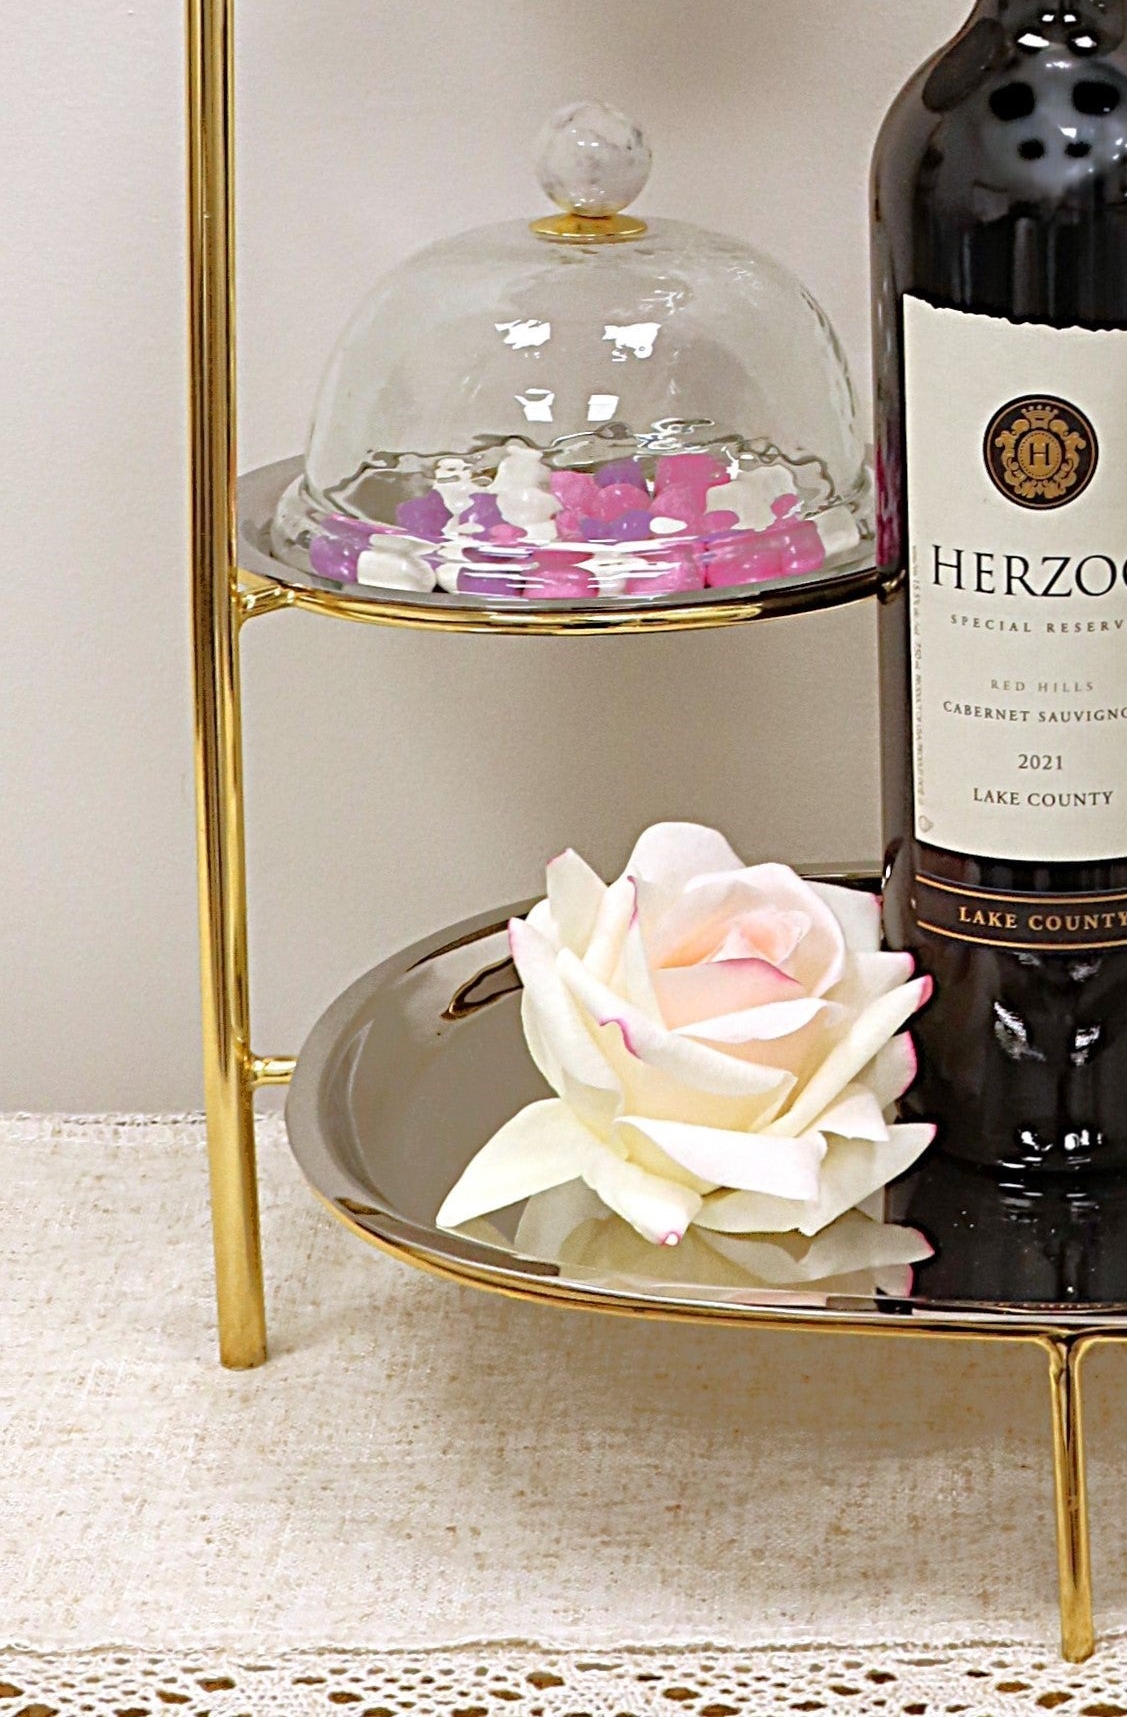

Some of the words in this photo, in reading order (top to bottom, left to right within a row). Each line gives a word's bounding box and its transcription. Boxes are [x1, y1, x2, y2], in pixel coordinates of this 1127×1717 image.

[1028, 442, 1051, 466] H
[950, 614, 1032, 633] SPECIAL
[990, 679, 1026, 692] RED
[1038, 681, 1094, 693] HILLS
[943, 700, 1031, 722] CABERNET
[1018, 753, 1063, 771] 2021
[973, 787, 1020, 806] LAKE
[1027, 790, 1114, 808] COUNTY
[958, 906, 1018, 929] LAKE
